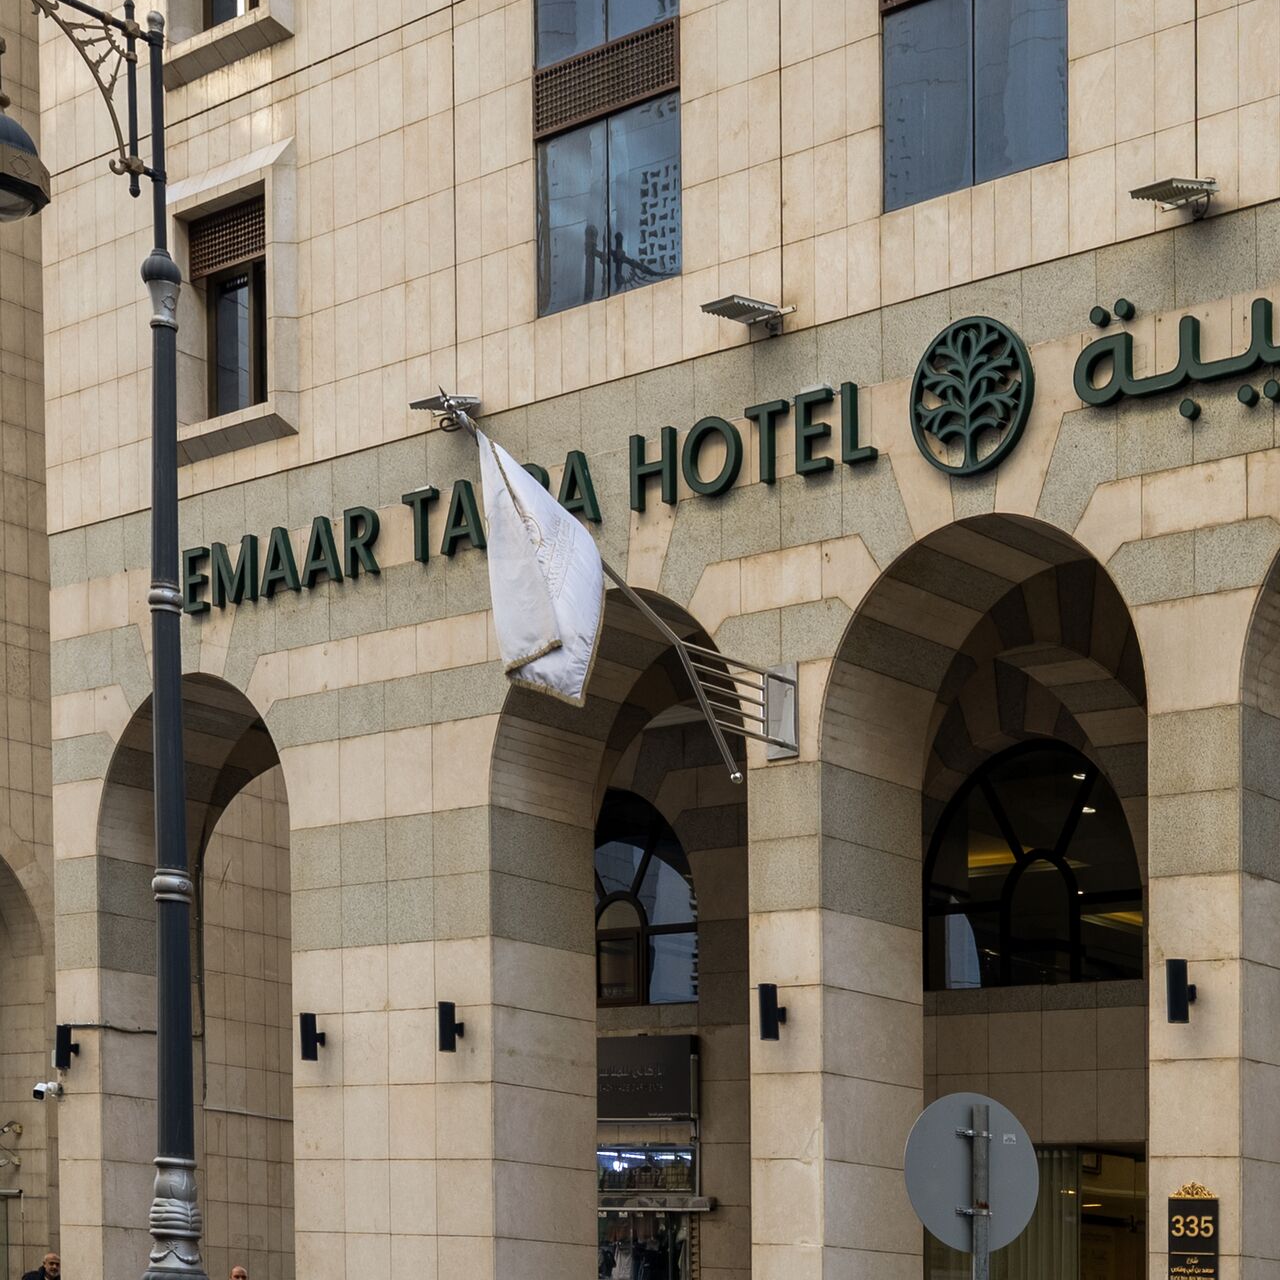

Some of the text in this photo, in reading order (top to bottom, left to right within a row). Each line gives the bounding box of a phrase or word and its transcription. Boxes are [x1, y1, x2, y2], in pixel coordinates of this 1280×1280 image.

[181, 505, 381, 616] EMAAR
[402, 450, 603, 564] TAA
[628, 381, 879, 513] HOTEL
[1171, 1215, 1215, 1238] 335
